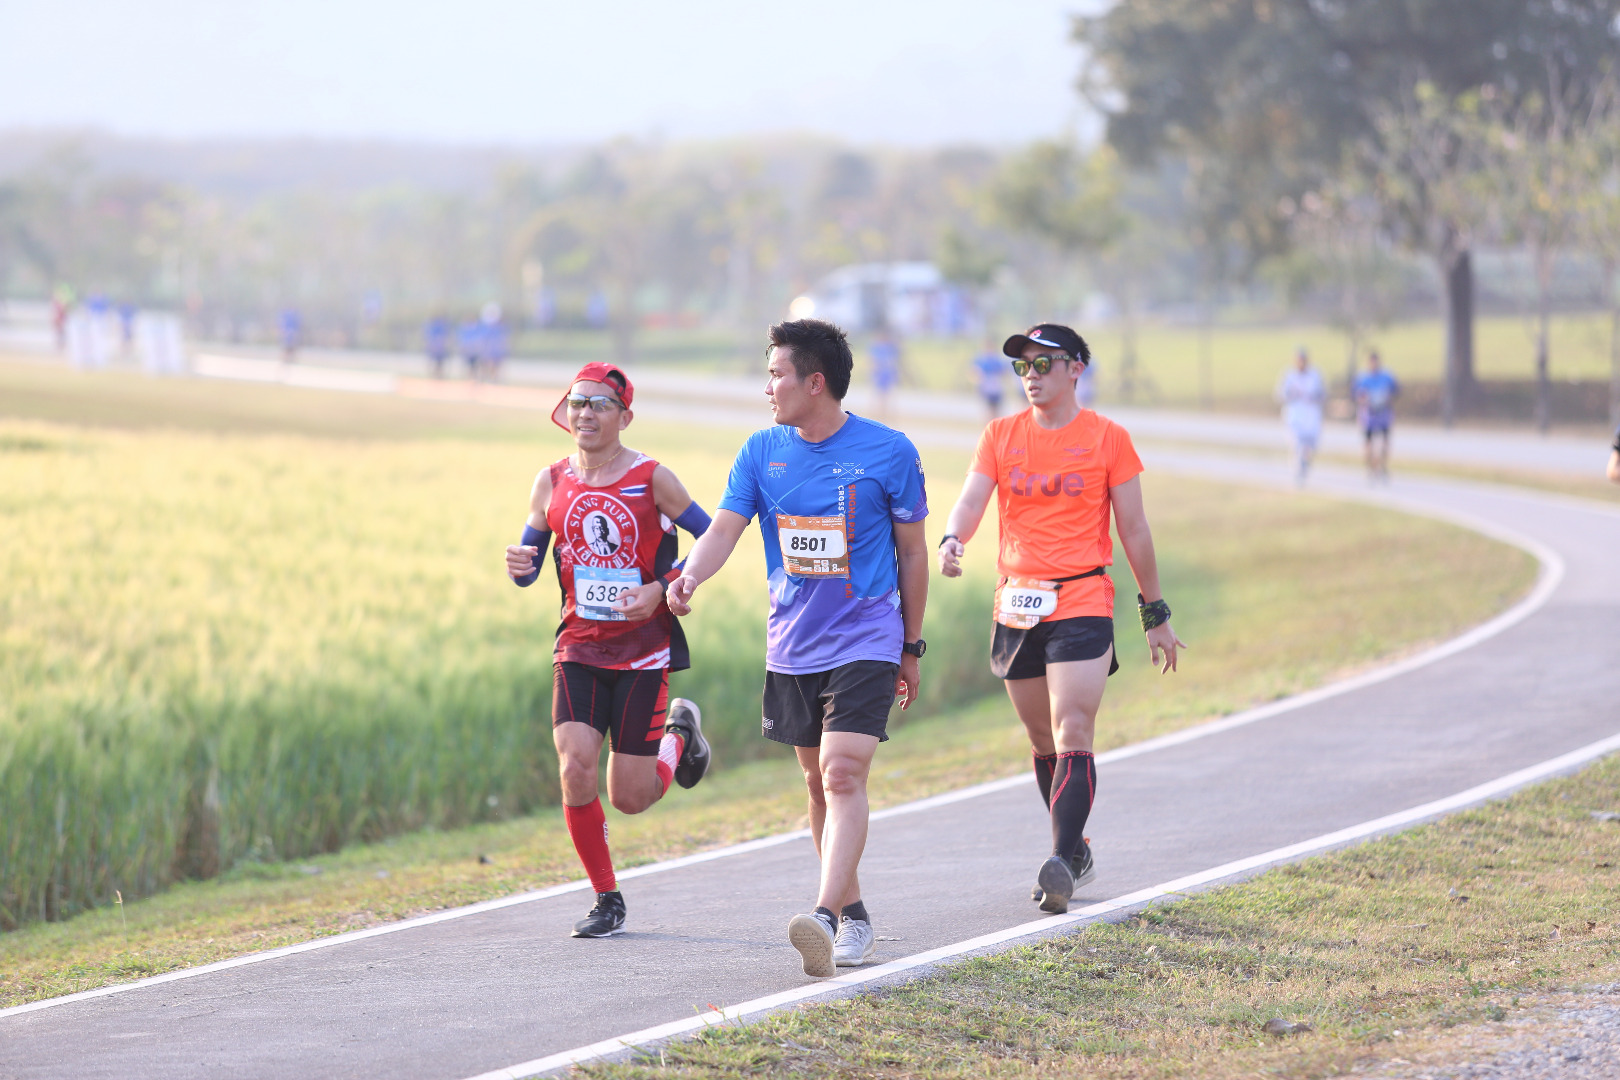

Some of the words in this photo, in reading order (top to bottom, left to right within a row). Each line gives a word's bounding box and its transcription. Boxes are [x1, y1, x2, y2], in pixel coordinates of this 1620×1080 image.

[1009, 466, 1084, 497] true
[570, 497, 598, 528] SIANG
[603, 500, 632, 529] PURE
[848, 484, 857, 520] SINGHA
[791, 536, 827, 552] 8501
[845, 583, 853, 599] RAI
[1011, 595, 1043, 609] 8520
